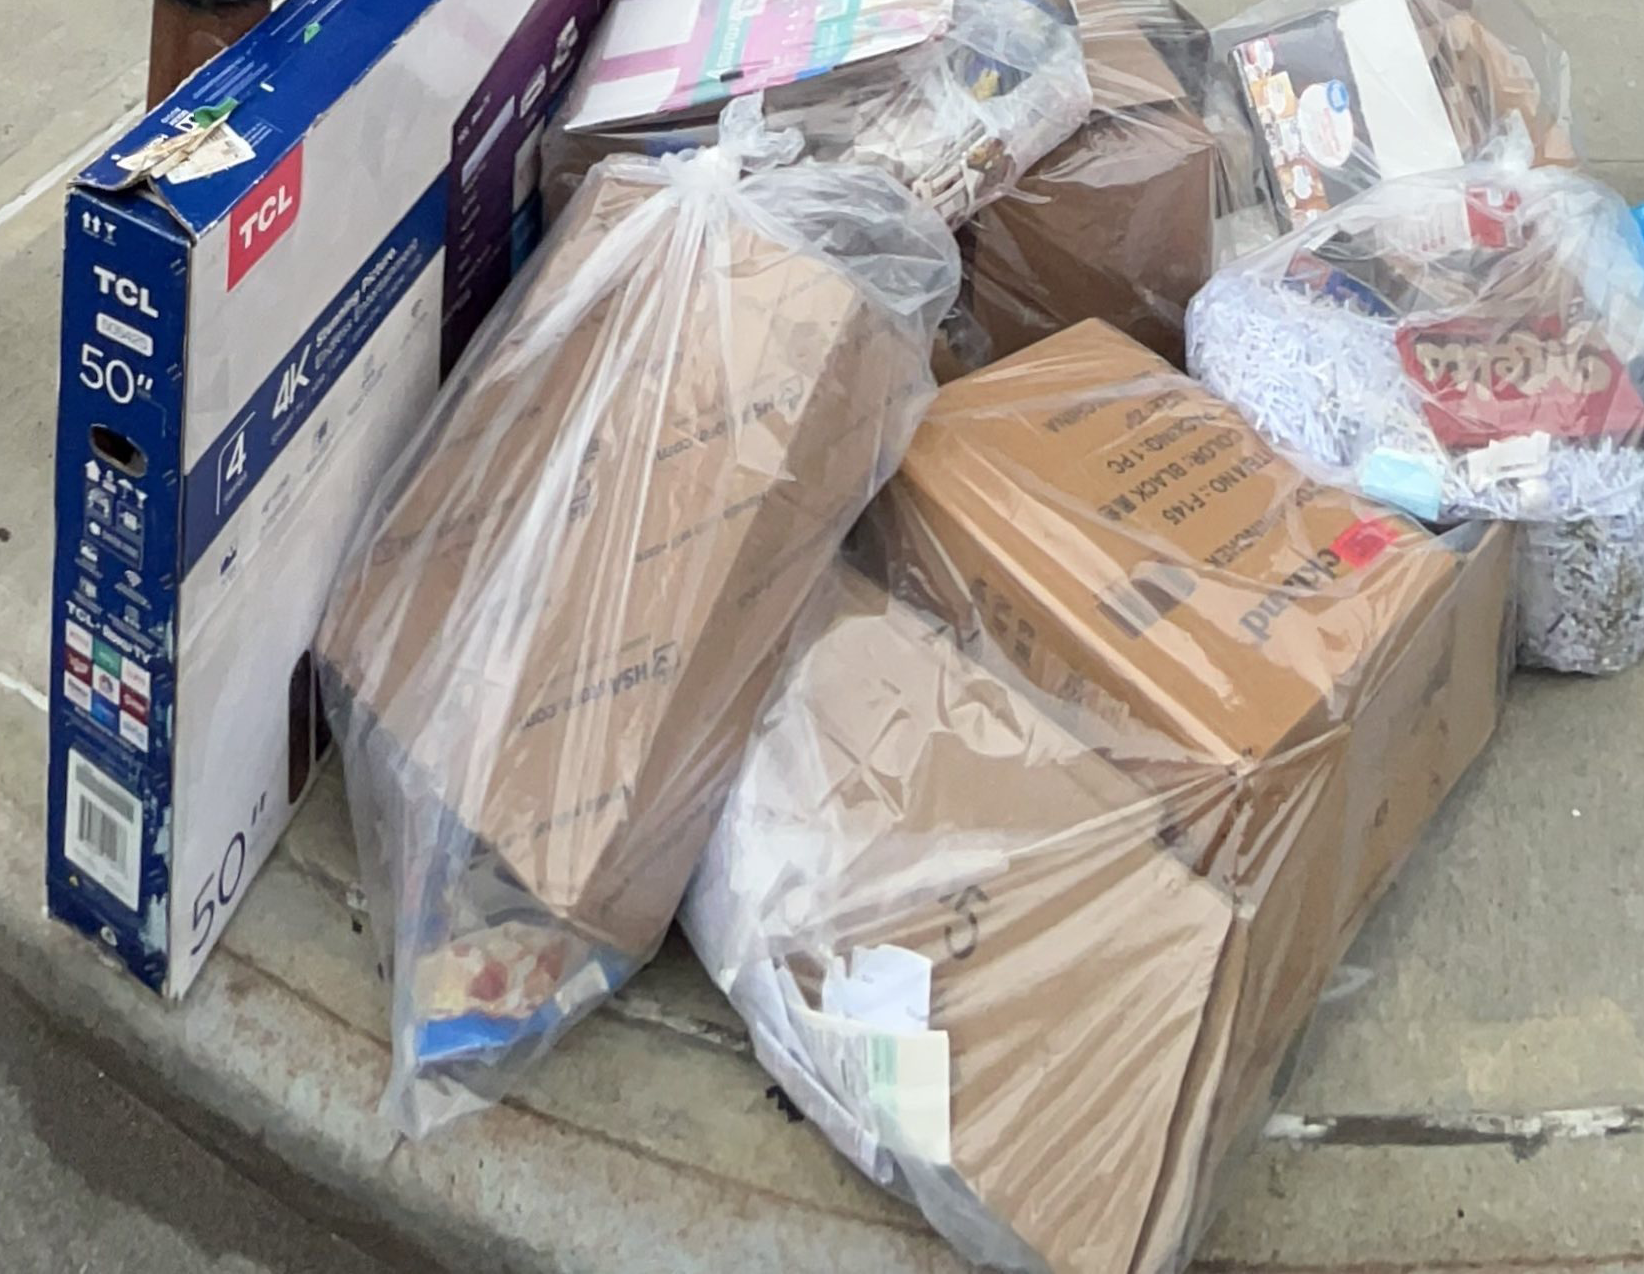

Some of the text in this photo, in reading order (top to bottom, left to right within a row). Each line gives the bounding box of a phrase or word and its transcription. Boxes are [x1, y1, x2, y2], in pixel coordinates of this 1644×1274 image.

[239, 181, 294, 251] TCL
[92, 264, 159, 319] TCL
[79, 343, 154, 404] 50"
[271, 342, 312, 420] 4K
[225, 430, 247, 483] 4
[1107, 455, 1136, 475] PC
[1129, 462, 1188, 504] BLACK
[1162, 492, 1207, 526] F145
[1239, 546, 1343, 642] ckland
[190, 790, 268, 957] 50"
